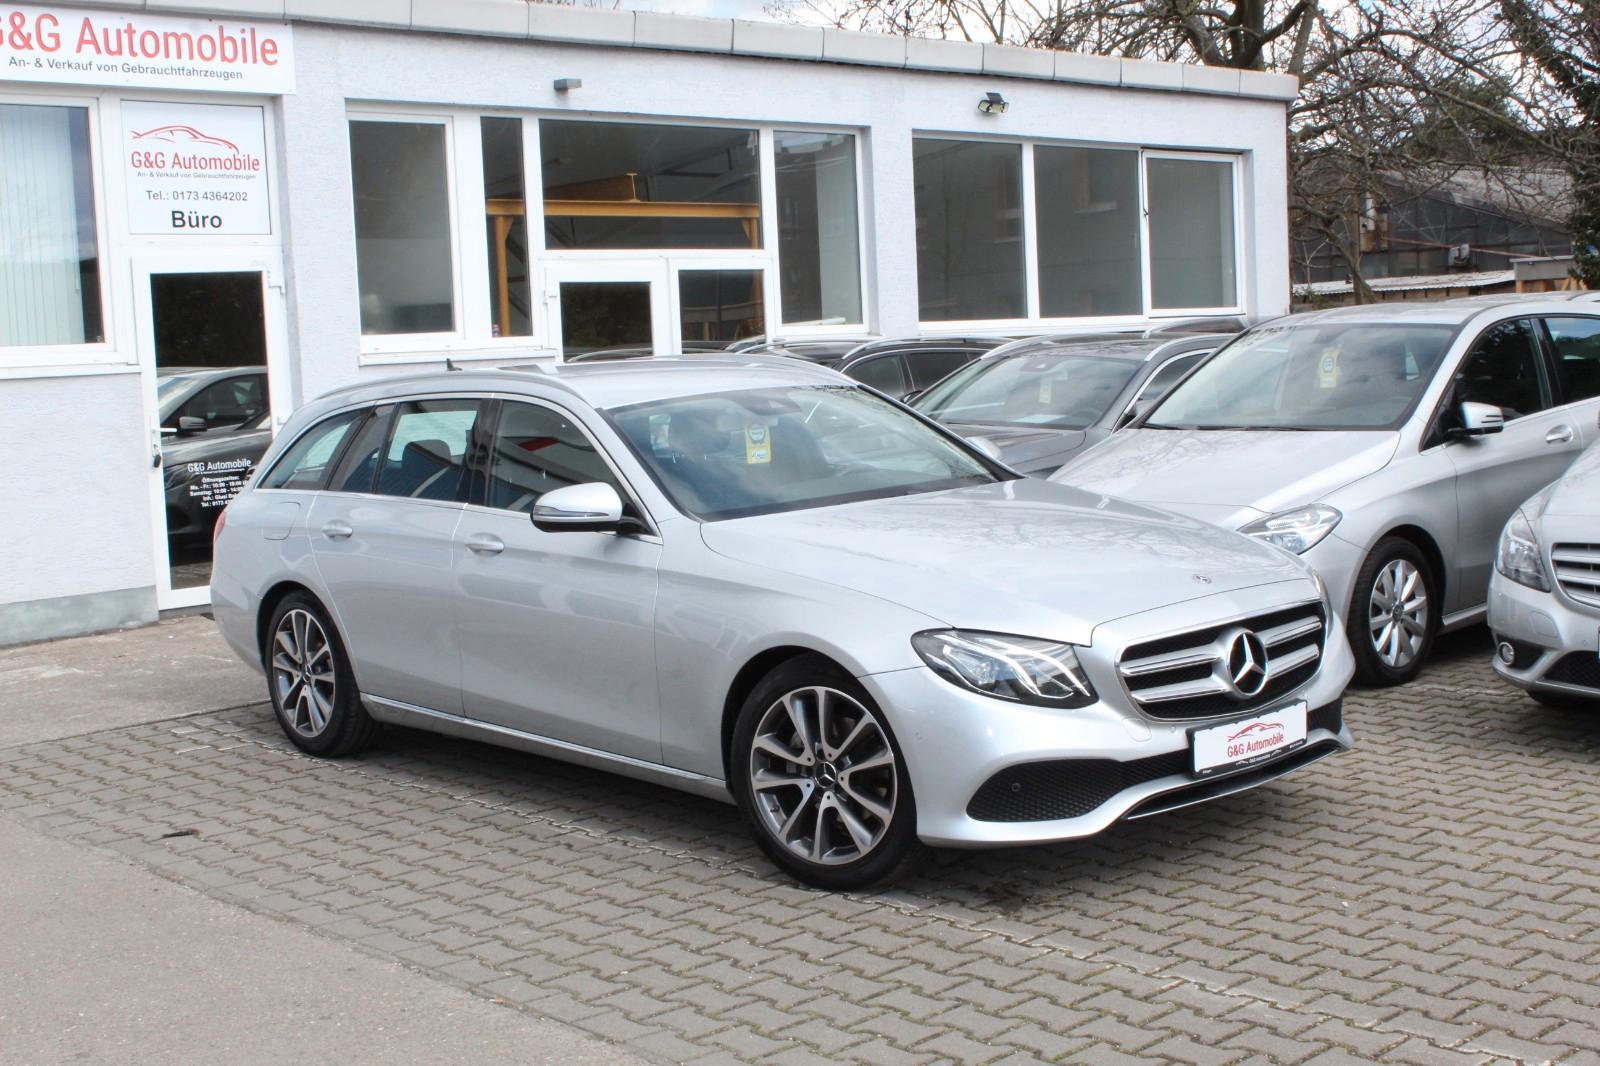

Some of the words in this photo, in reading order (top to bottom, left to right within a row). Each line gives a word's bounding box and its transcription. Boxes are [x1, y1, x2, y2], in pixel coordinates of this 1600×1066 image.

[0, 11, 61, 53] &G
[75, 17, 278, 66] Automobile
[8, 56, 31, 68] An-
[34, 58, 43, 69] &
[47, 58, 93, 72] Verkauf
[97, 64, 118, 73] von
[121, 63, 243, 81] Gebrauchtfahrzeugen
[131, 151, 165, 169] G&G
[171, 151, 260, 171] Automobile
[146, 190, 170, 201] Tel.:
[172, 191, 199, 201] 0173
[202, 191, 248, 202] 4364202
[171, 210, 223, 229] Büro
[187, 462, 205, 473] G&G
[207, 458, 252, 471] Automobile
[1227, 743, 1245, 758] G&G
[1246, 732, 1284, 754] Automobile
